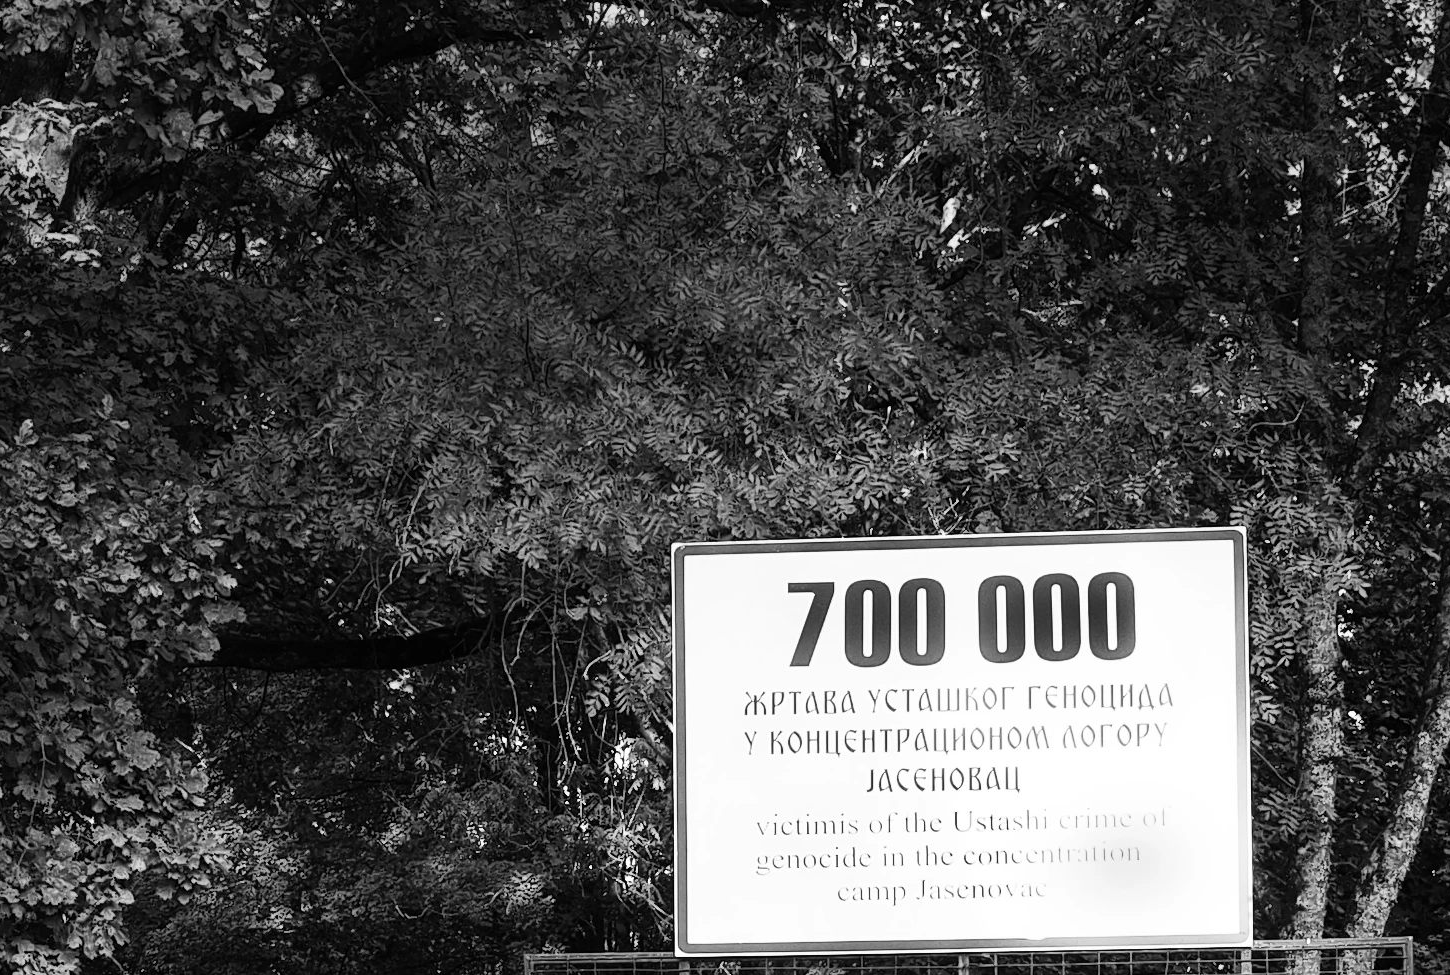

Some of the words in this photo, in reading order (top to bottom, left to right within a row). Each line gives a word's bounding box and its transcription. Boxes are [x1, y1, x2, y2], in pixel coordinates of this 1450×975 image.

[787, 578, 946, 668] 700
[978, 571, 1136, 664] 000
[744, 690, 856, 716] ЖРТАВА
[868, 687, 1014, 713] УСТАШКОГ
[1028, 683, 1173, 711] ГЕНОЦИДА
[744, 731, 758, 756] У
[770, 726, 1049, 758] КОНЦЕНТРАЦИОНОМ
[1062, 722, 1168, 748] ЛОГОРУ
[866, 766, 1020, 793] ЈАСЕНОВАЦ
[757, 813, 858, 836] victimis
[869, 812, 898, 834] of
[905, 812, 942, 833] the
[954, 809, 1046, 832] Ustashi
[1143, 806, 1171, 828] of
[756, 846, 871, 876] genocide
[883, 846, 904, 867] in
[916, 845, 953, 866] the
[964, 841, 1141, 867] concentration
[838, 886, 906, 906] camp
[916, 880, 1046, 900] Jasenovac
